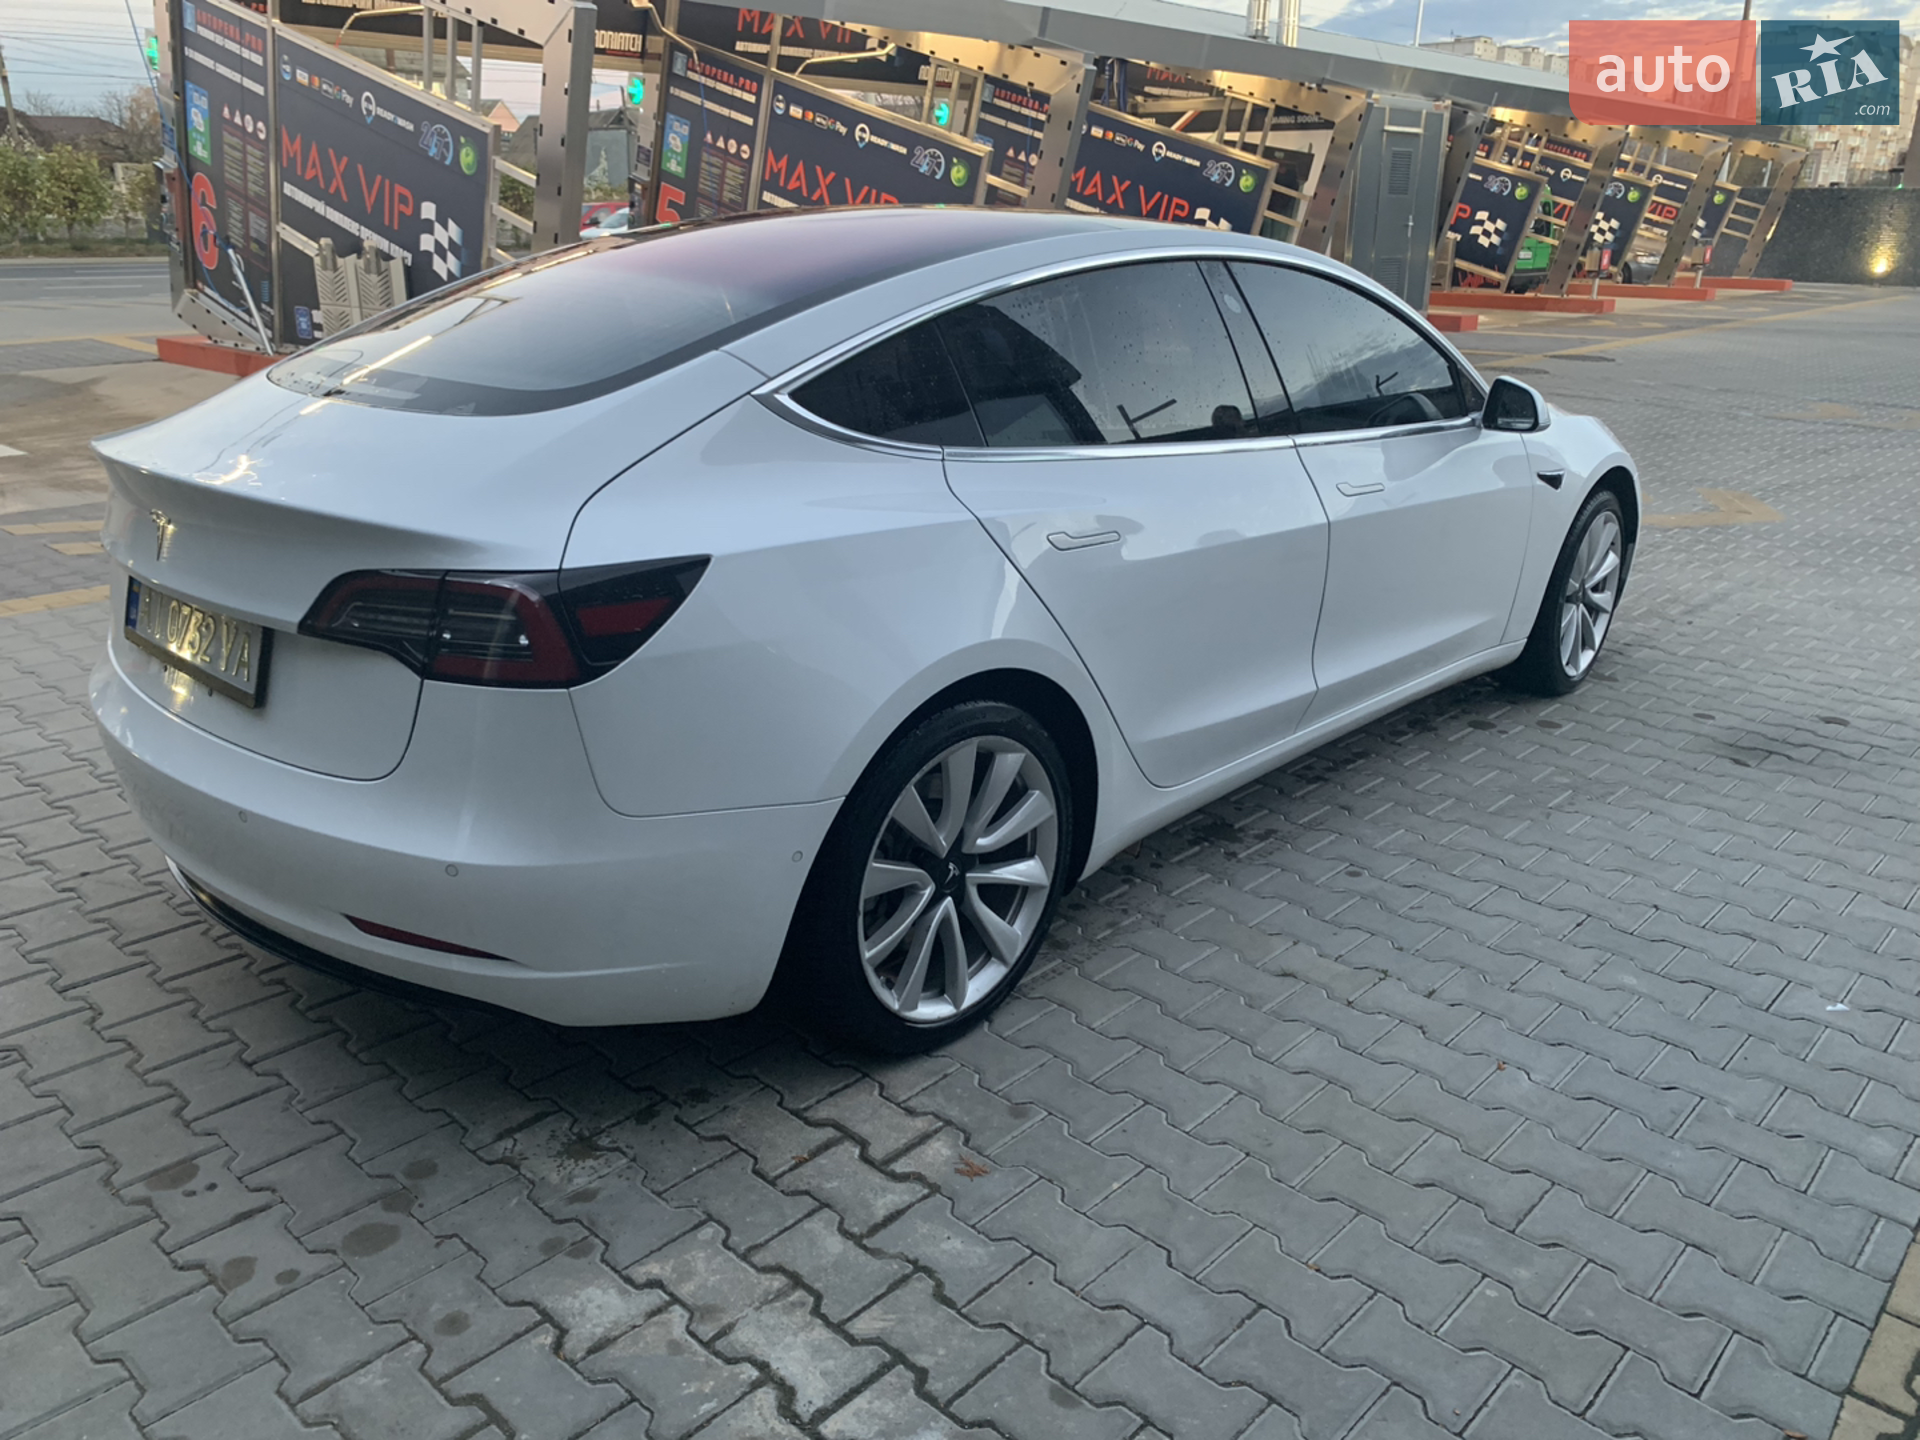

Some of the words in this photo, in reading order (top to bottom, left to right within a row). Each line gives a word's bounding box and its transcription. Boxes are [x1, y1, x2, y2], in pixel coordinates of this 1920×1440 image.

[281, 124, 348, 203] MAX
[357, 163, 414, 231] VIP
[656, 181, 686, 224] 5
[764, 146, 837, 206] MAX
[1071, 165, 1131, 210] MAX
[1138, 184, 1190, 223] VIP
[191, 172, 219, 270] 6
